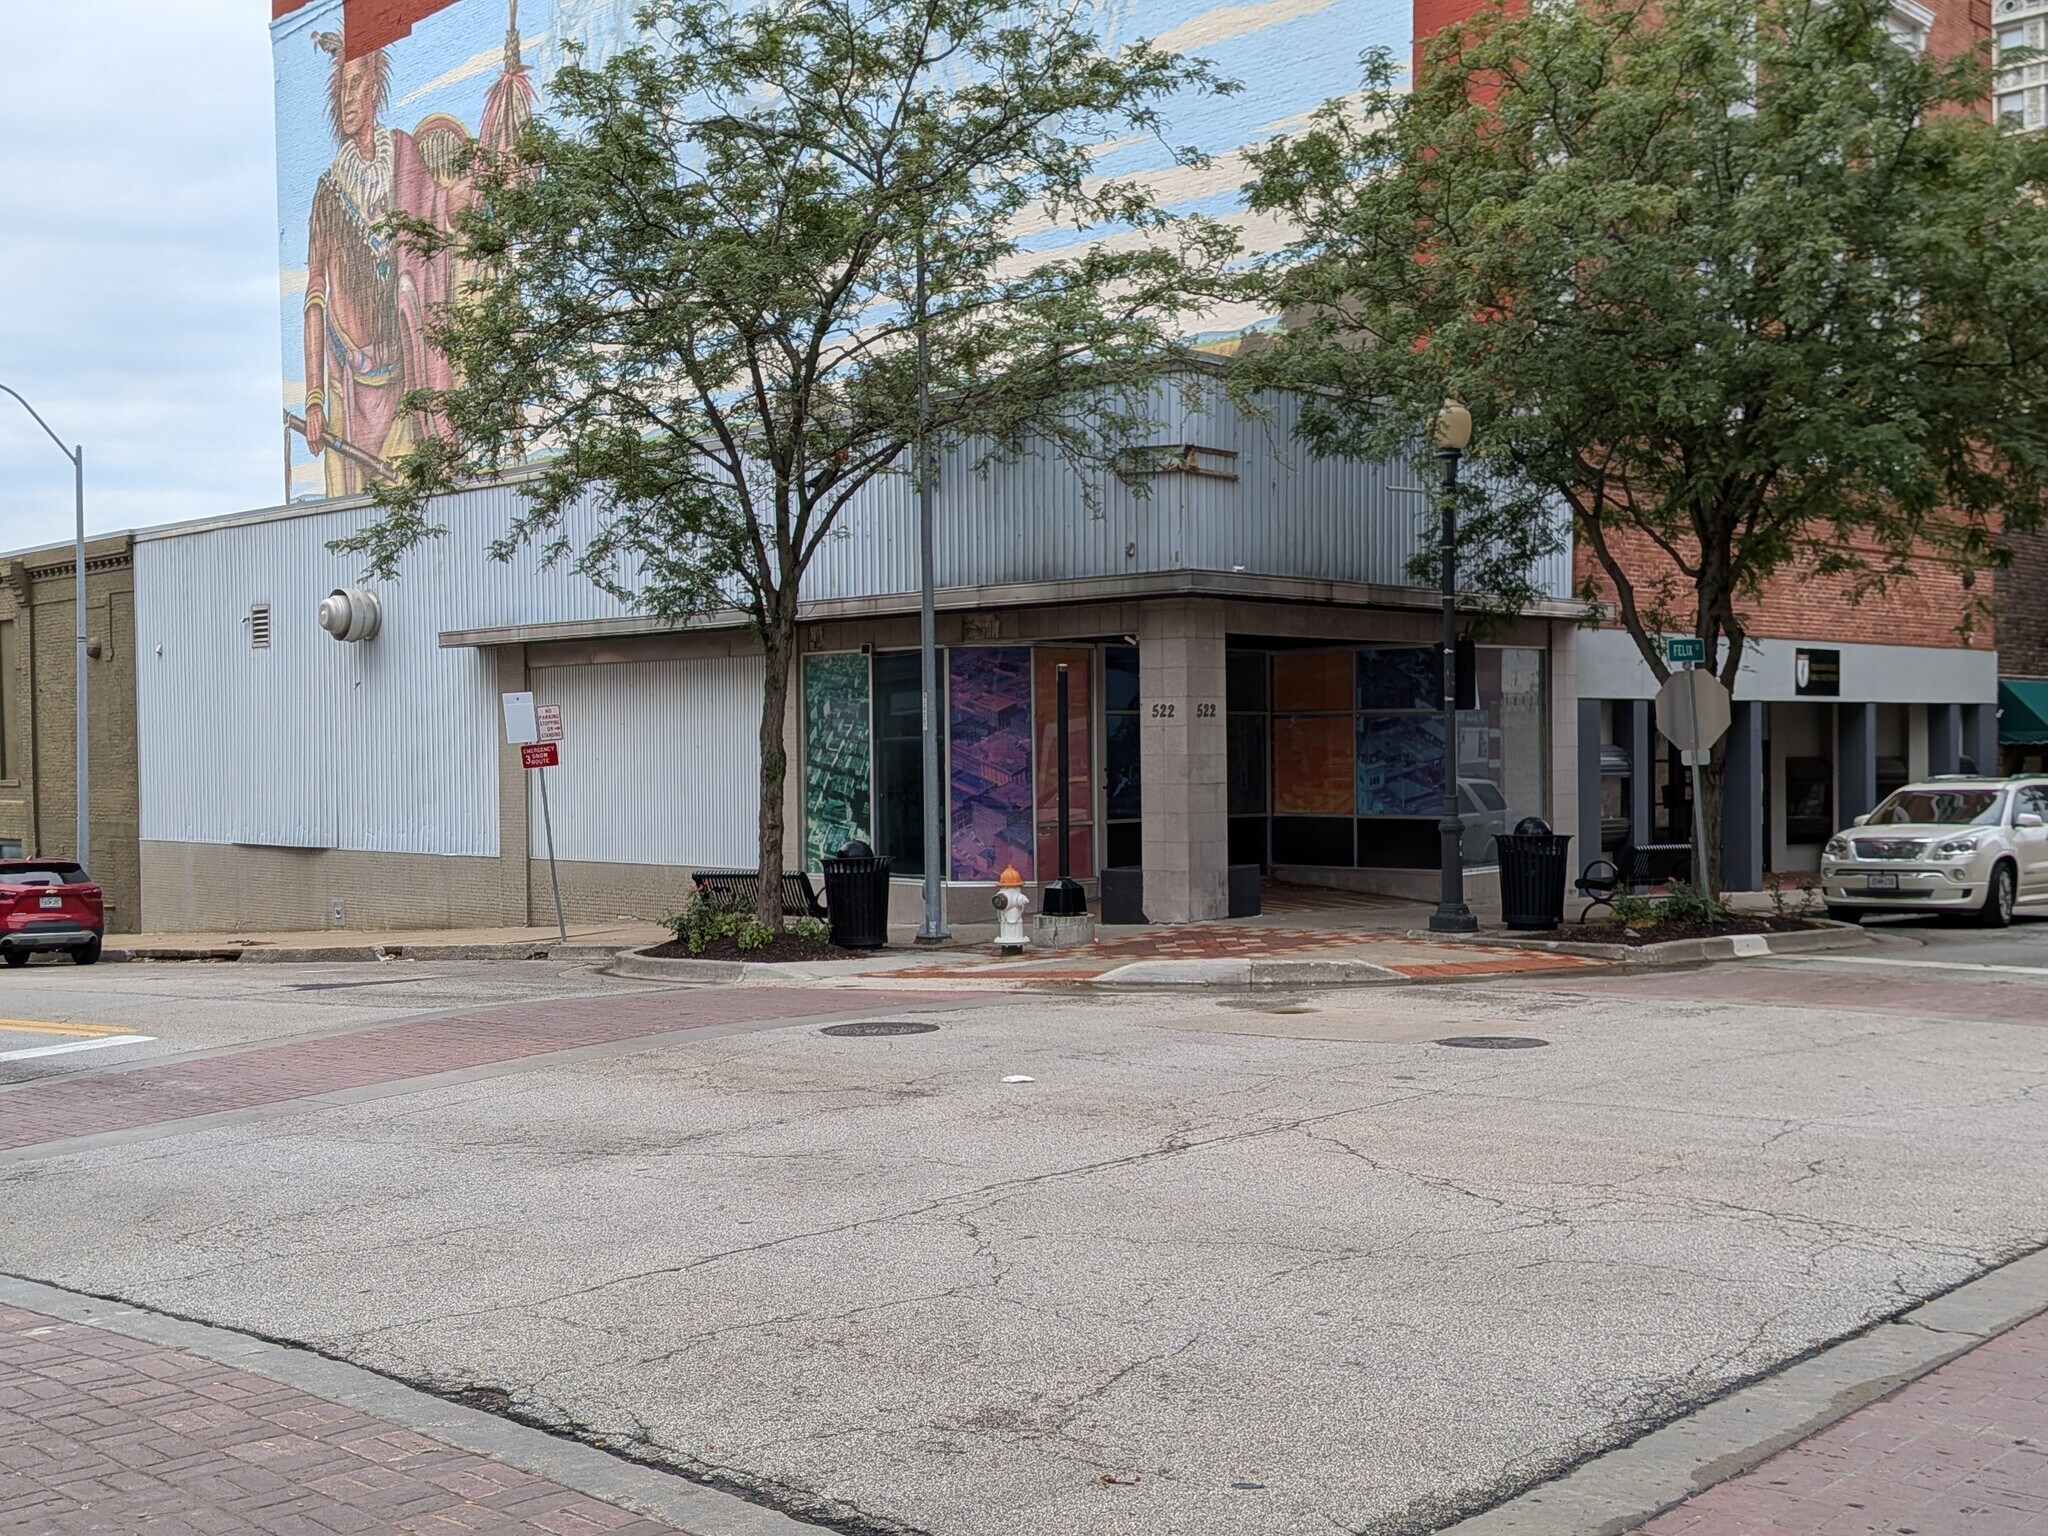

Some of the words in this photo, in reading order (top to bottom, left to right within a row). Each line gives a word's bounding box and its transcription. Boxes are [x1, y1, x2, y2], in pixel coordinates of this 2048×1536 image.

[1673, 644, 1693, 656] FELIX
[1152, 703, 1175, 718] 522
[1196, 703, 1216, 718] 522
[523, 746, 555, 754] EMERGENCY
[525, 755, 531, 765] 3
